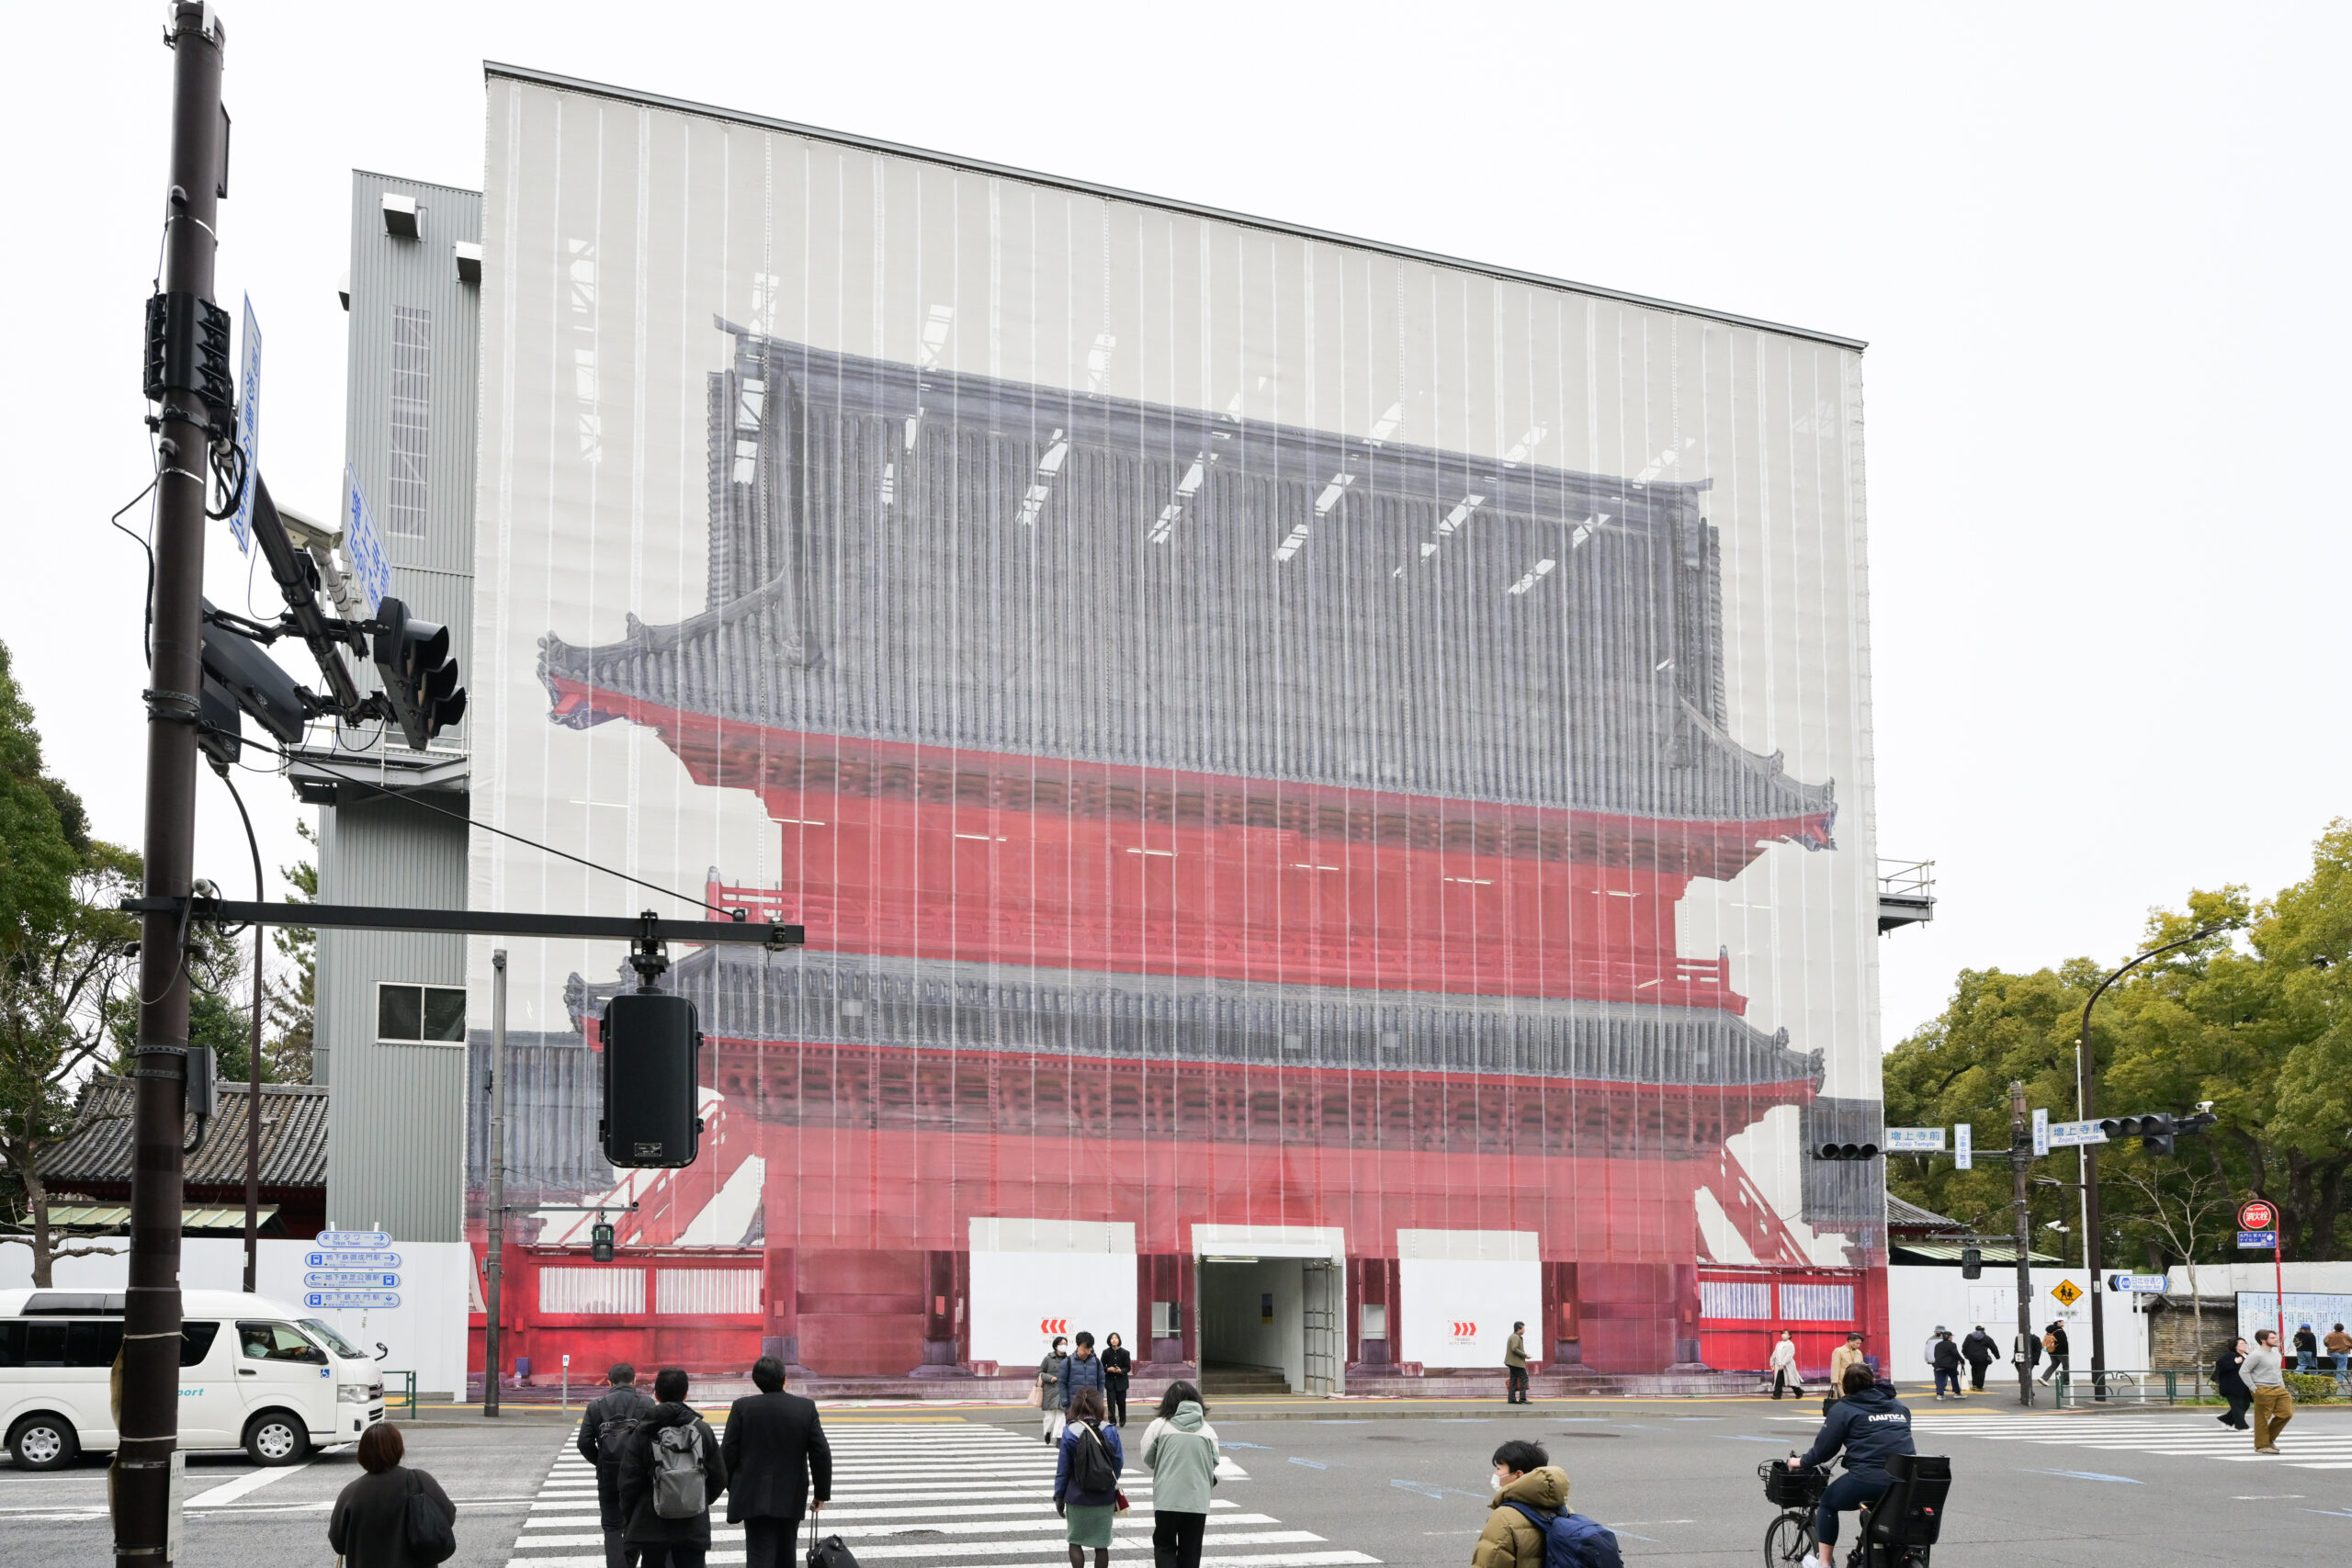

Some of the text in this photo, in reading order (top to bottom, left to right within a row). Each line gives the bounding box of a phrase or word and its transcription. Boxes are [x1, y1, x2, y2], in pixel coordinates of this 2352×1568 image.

[350, 523, 368, 582] Zojoji
[1891, 1131, 1940, 1141] 増上寺前
[2245, 1211, 2268, 1222] 消火栓
[2132, 1277, 2162, 1285] 日比谷通り
[1868, 1413, 1907, 1423] NAUTICA
